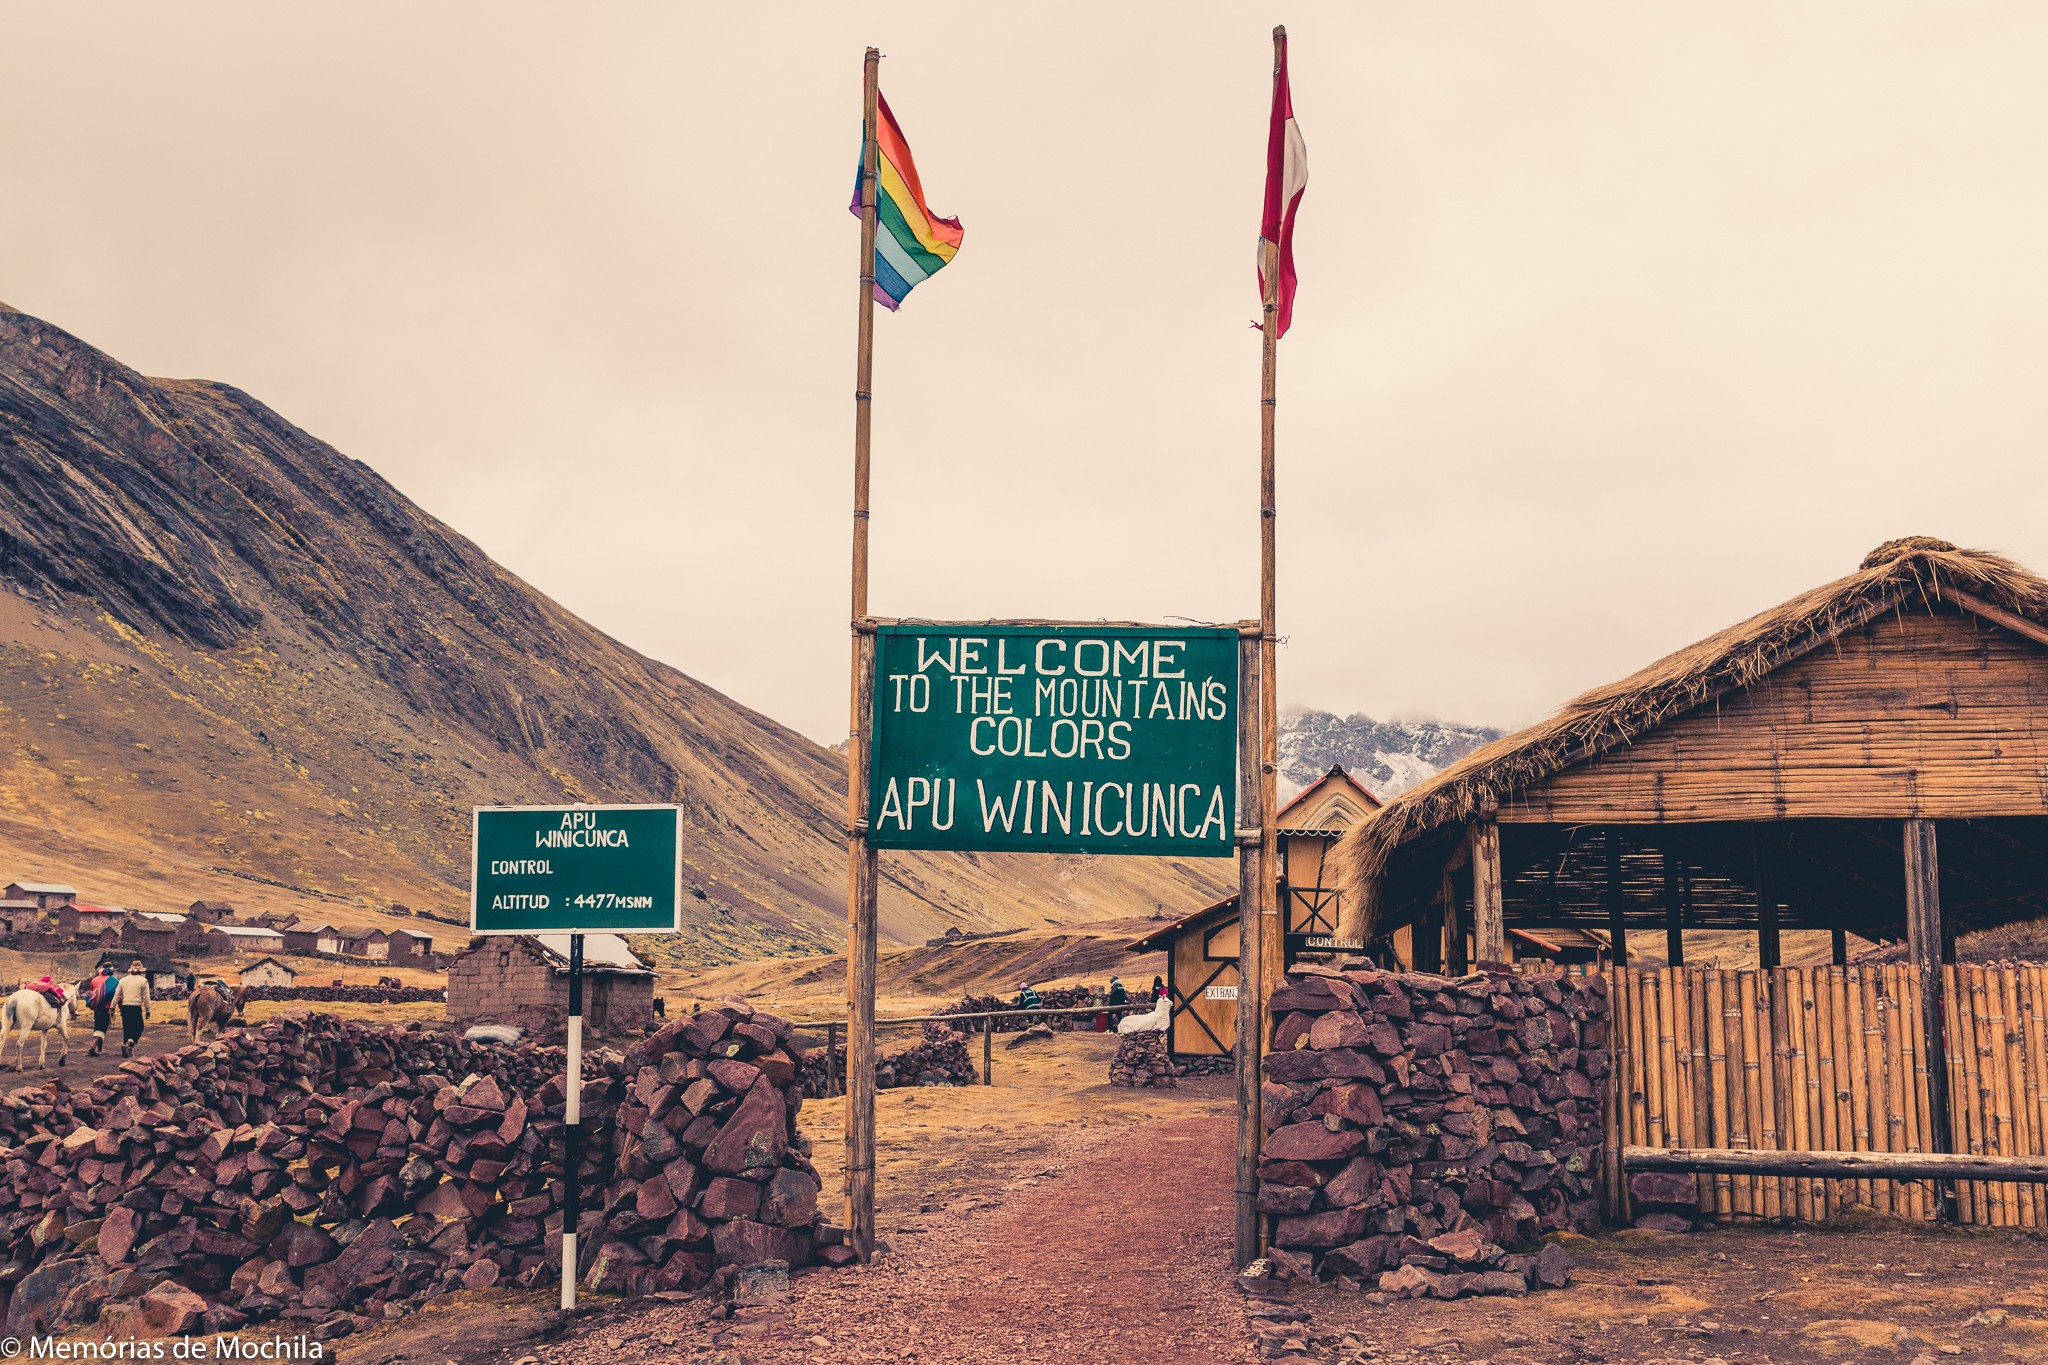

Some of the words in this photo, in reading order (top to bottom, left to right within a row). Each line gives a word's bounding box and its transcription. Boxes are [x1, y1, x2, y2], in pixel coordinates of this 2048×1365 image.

[917, 638, 1186, 678] WELCOME
[889, 674, 930, 713] TO
[950, 676, 1013, 715] THE
[970, 716, 1133, 760] COLORS
[560, 812, 596, 830] APU
[876, 777, 955, 831] APU
[976, 778, 1226, 841] WINICUNCA
[535, 830, 629, 848] WINICUNCA
[491, 860, 553, 875] CONTROL
[492, 895, 550, 909] ALTITUD
